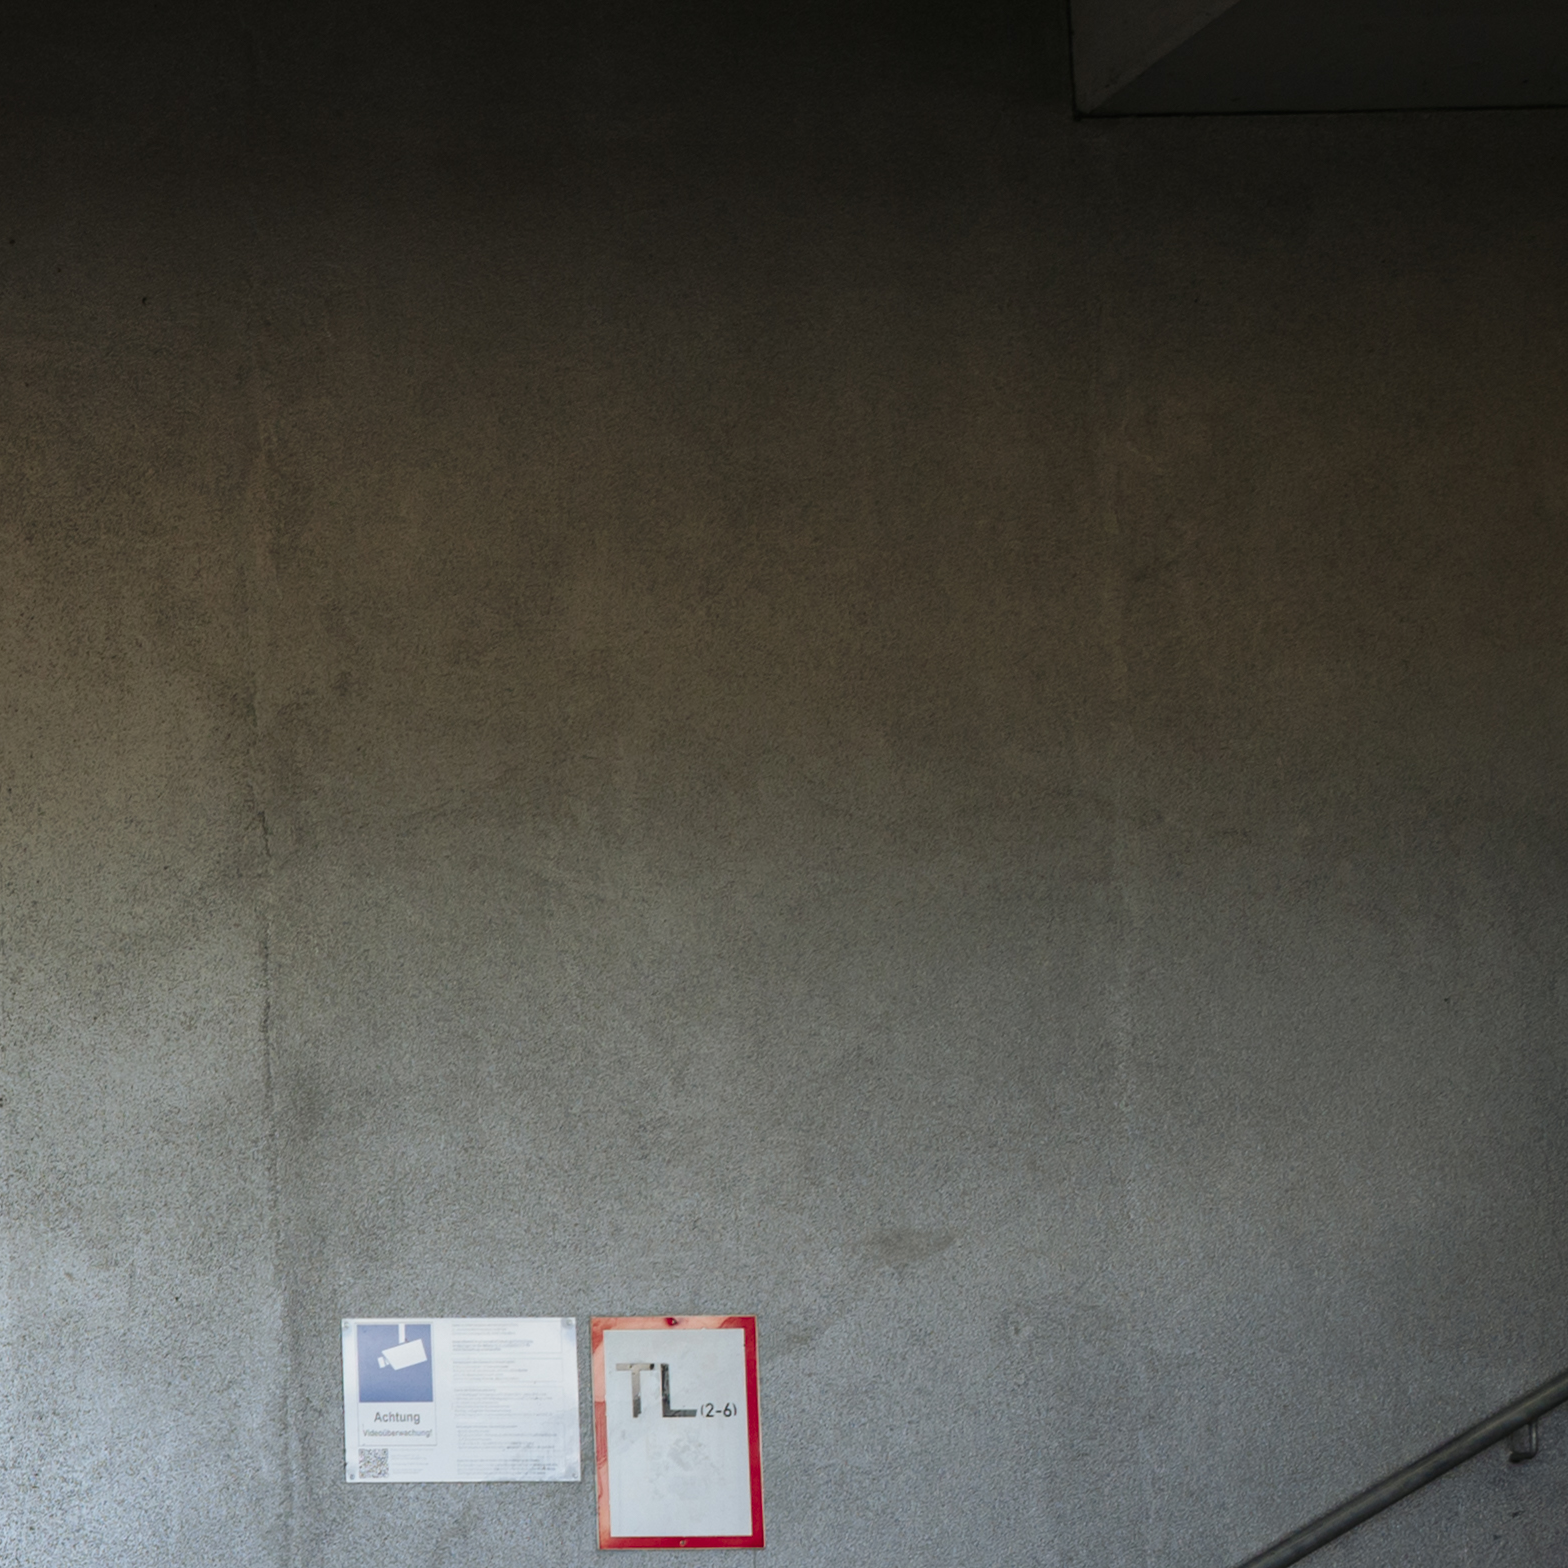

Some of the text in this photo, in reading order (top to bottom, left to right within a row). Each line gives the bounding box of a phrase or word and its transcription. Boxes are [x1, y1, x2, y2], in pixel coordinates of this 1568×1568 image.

[615, 1363, 737, 1418] TL (2-6)
[374, 1411, 420, 1425] Achtung
